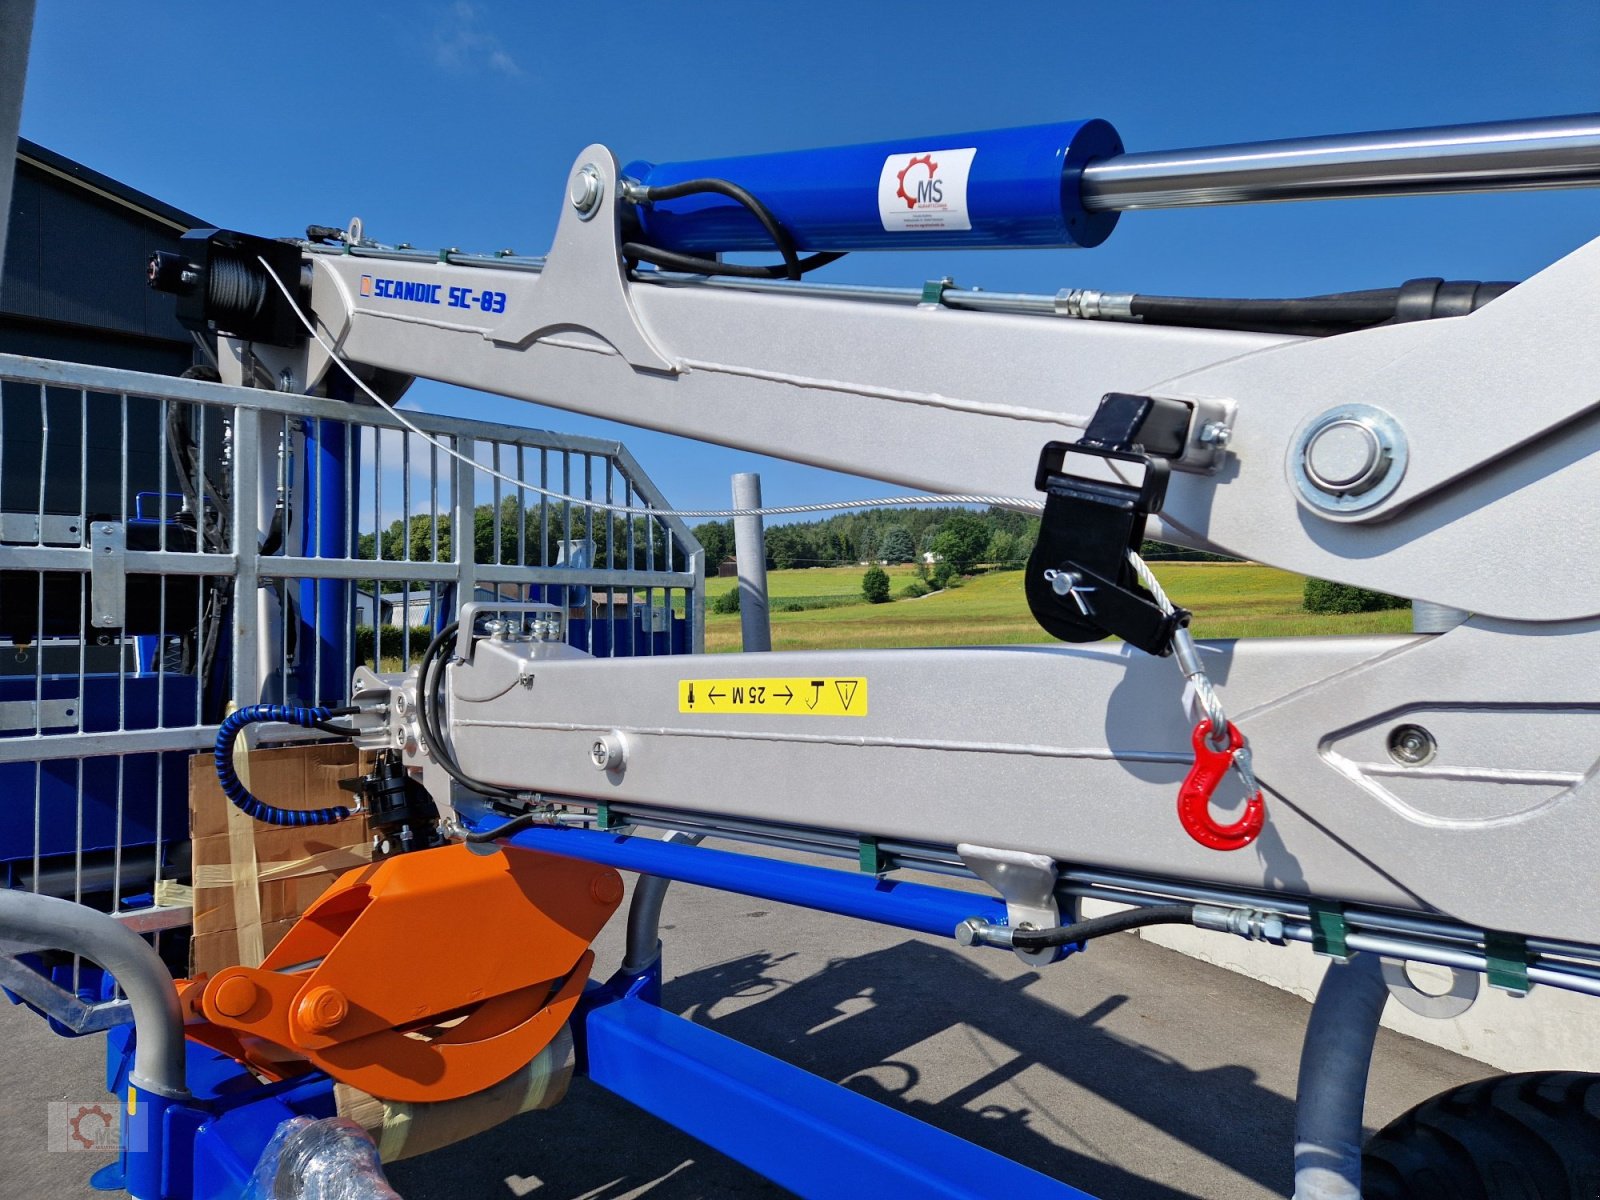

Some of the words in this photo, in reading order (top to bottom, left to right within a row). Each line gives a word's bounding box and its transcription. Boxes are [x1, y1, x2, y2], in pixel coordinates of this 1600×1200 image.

[917, 179, 943, 203] MS
[374, 278, 442, 304] SCANDIC
[447, 286, 507, 314] SC-83
[732, 687, 744, 704] M
[749, 686, 766, 704] 25
